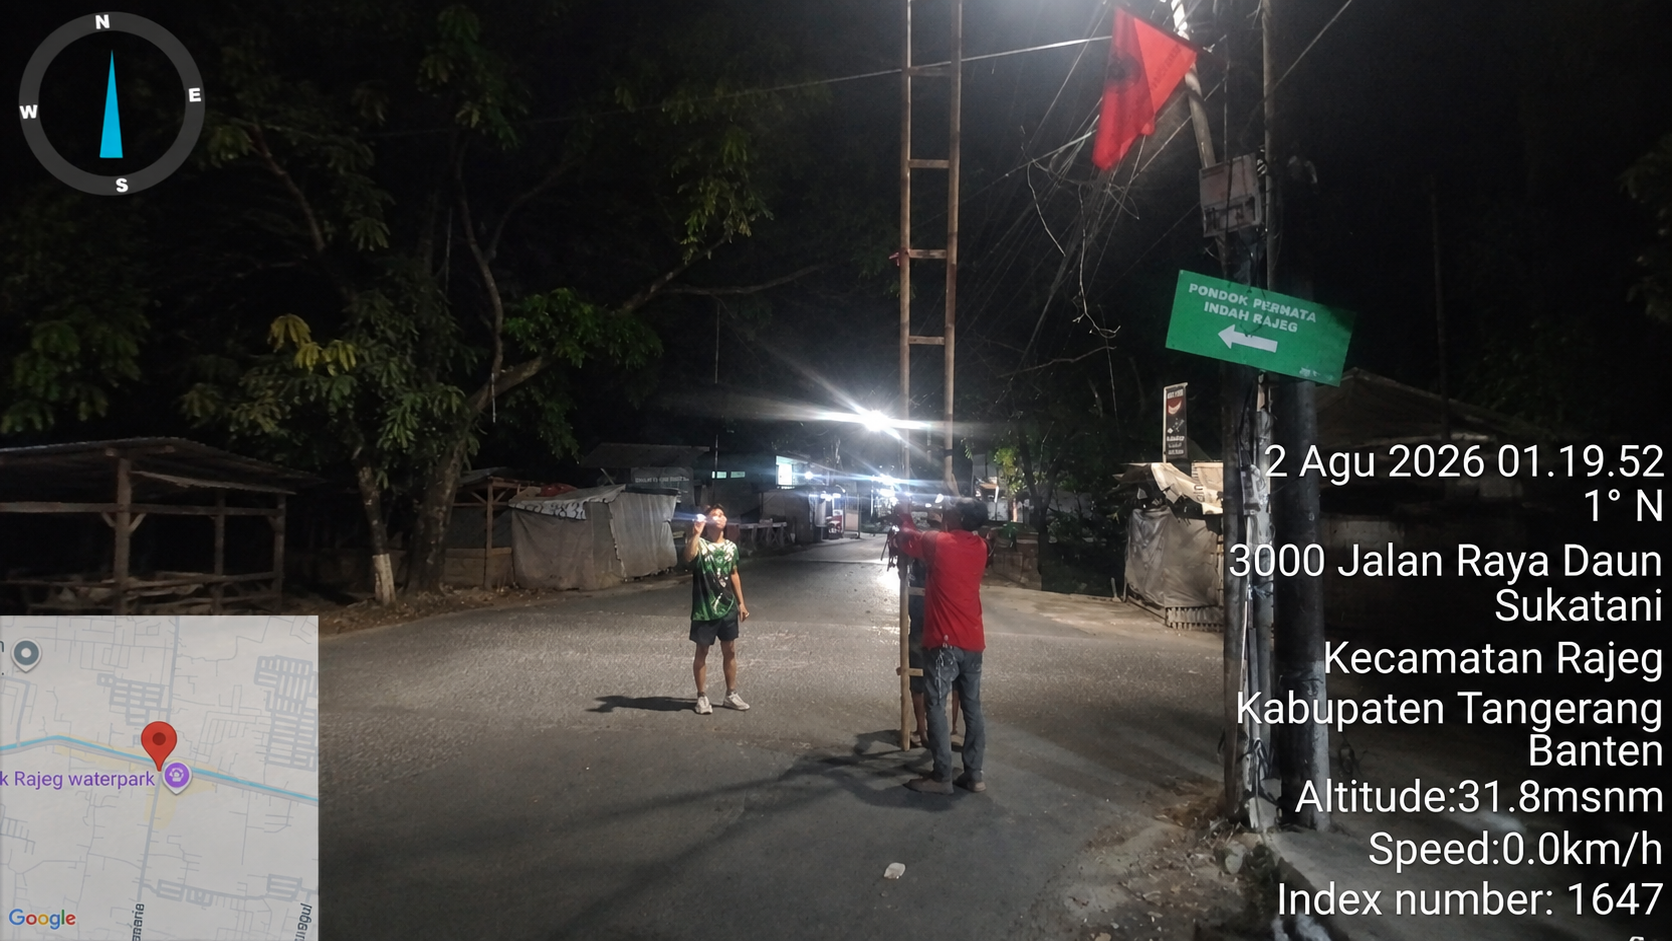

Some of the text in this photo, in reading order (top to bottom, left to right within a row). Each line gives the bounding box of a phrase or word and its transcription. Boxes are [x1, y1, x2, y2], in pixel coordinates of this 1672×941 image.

[1188, 283, 1248, 306] PONDOK
[1204, 301, 1298, 333] INDAH RAJEG
